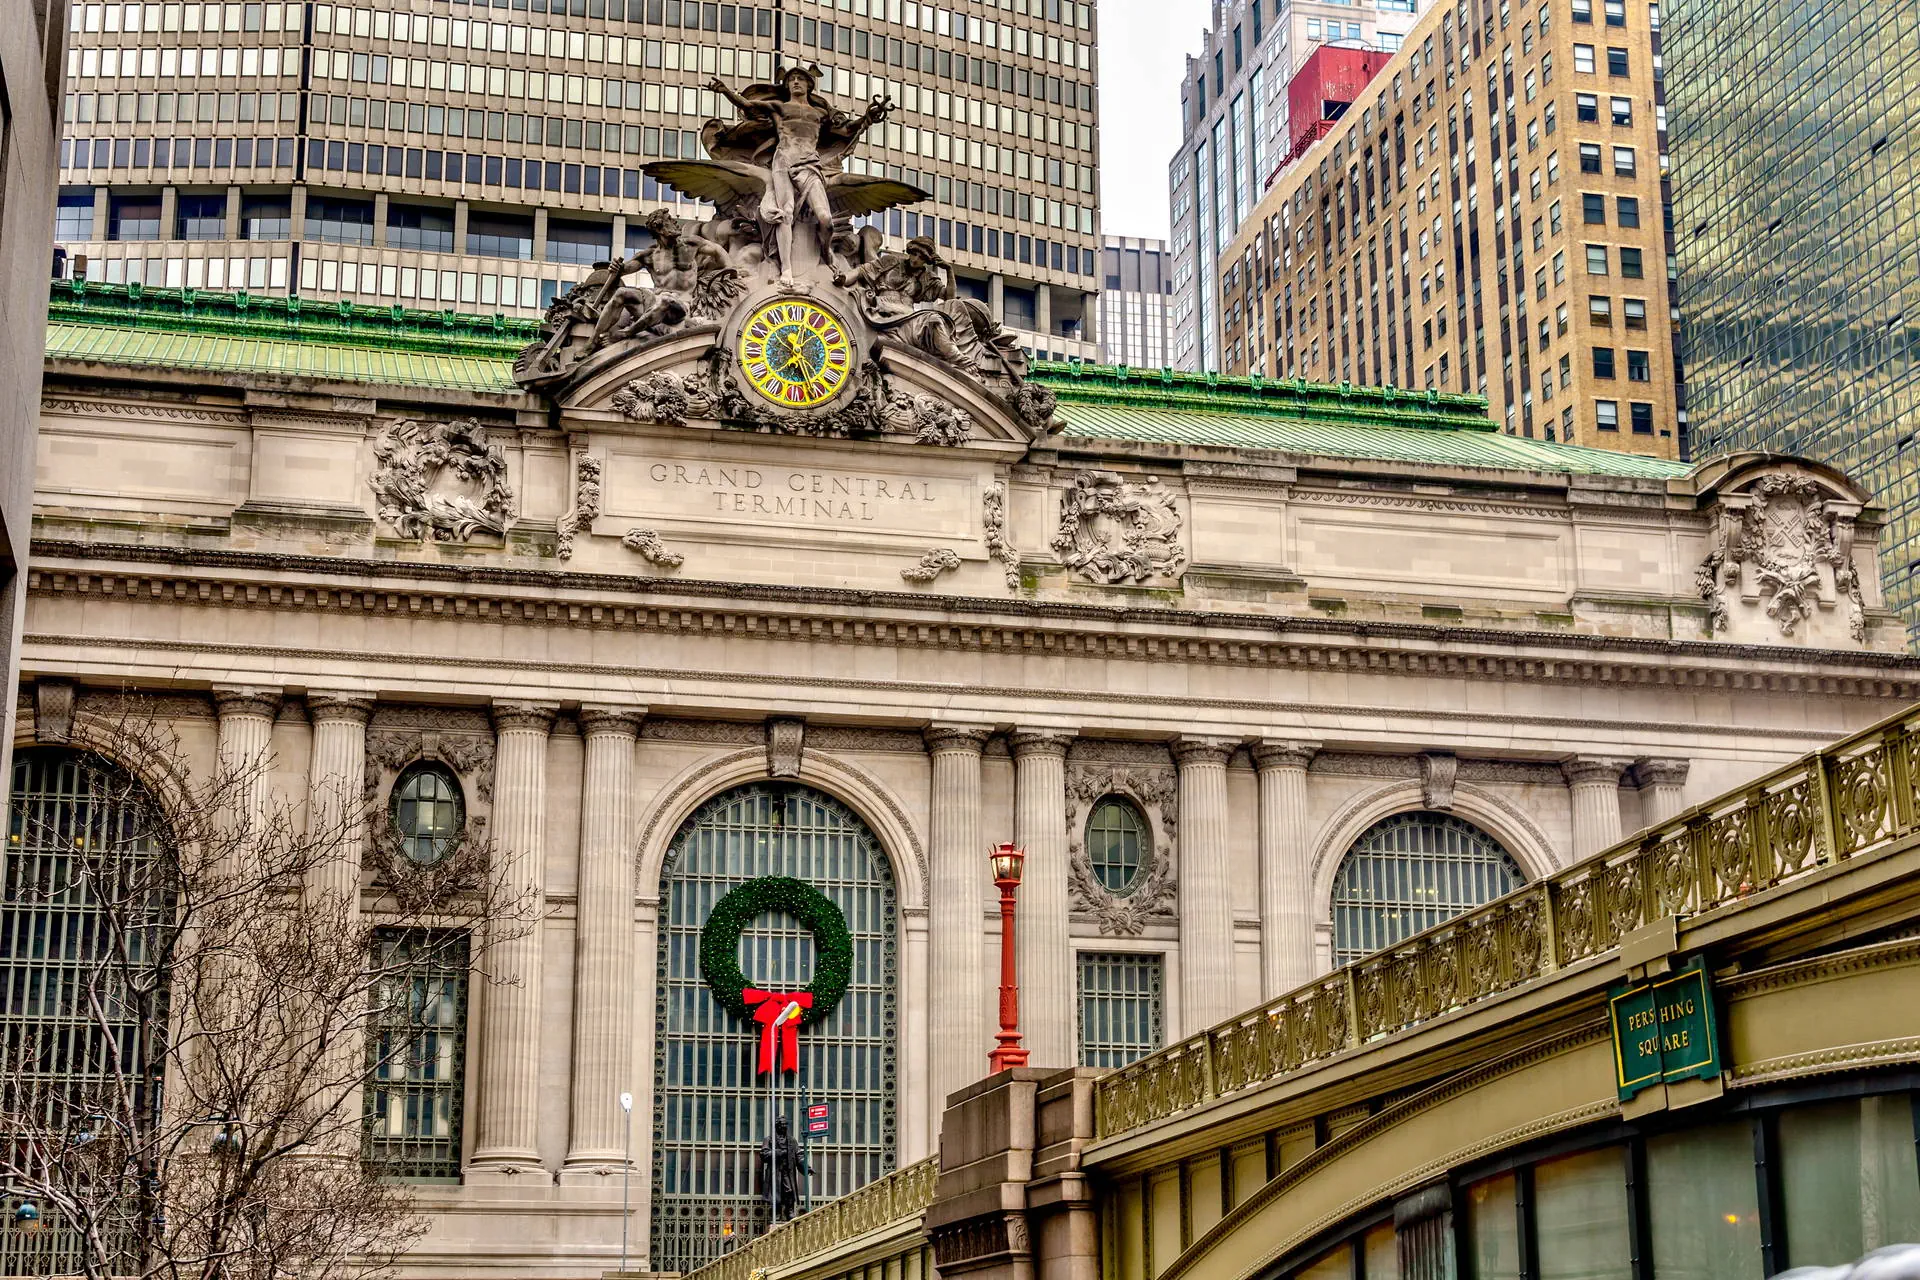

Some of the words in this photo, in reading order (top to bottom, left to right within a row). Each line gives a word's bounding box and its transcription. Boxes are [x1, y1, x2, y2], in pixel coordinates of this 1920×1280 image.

[768, 309, 783, 325] XI
[791, 304, 802, 321] XII
[751, 324, 768, 337] X
[650, 463, 763, 489] GRAND
[788, 473, 936, 501] CENTRAL
[713, 491, 874, 520] TERMINAL
[1629, 999, 1694, 1031] PERSHING
[1638, 1031, 1690, 1057] SQUARE
